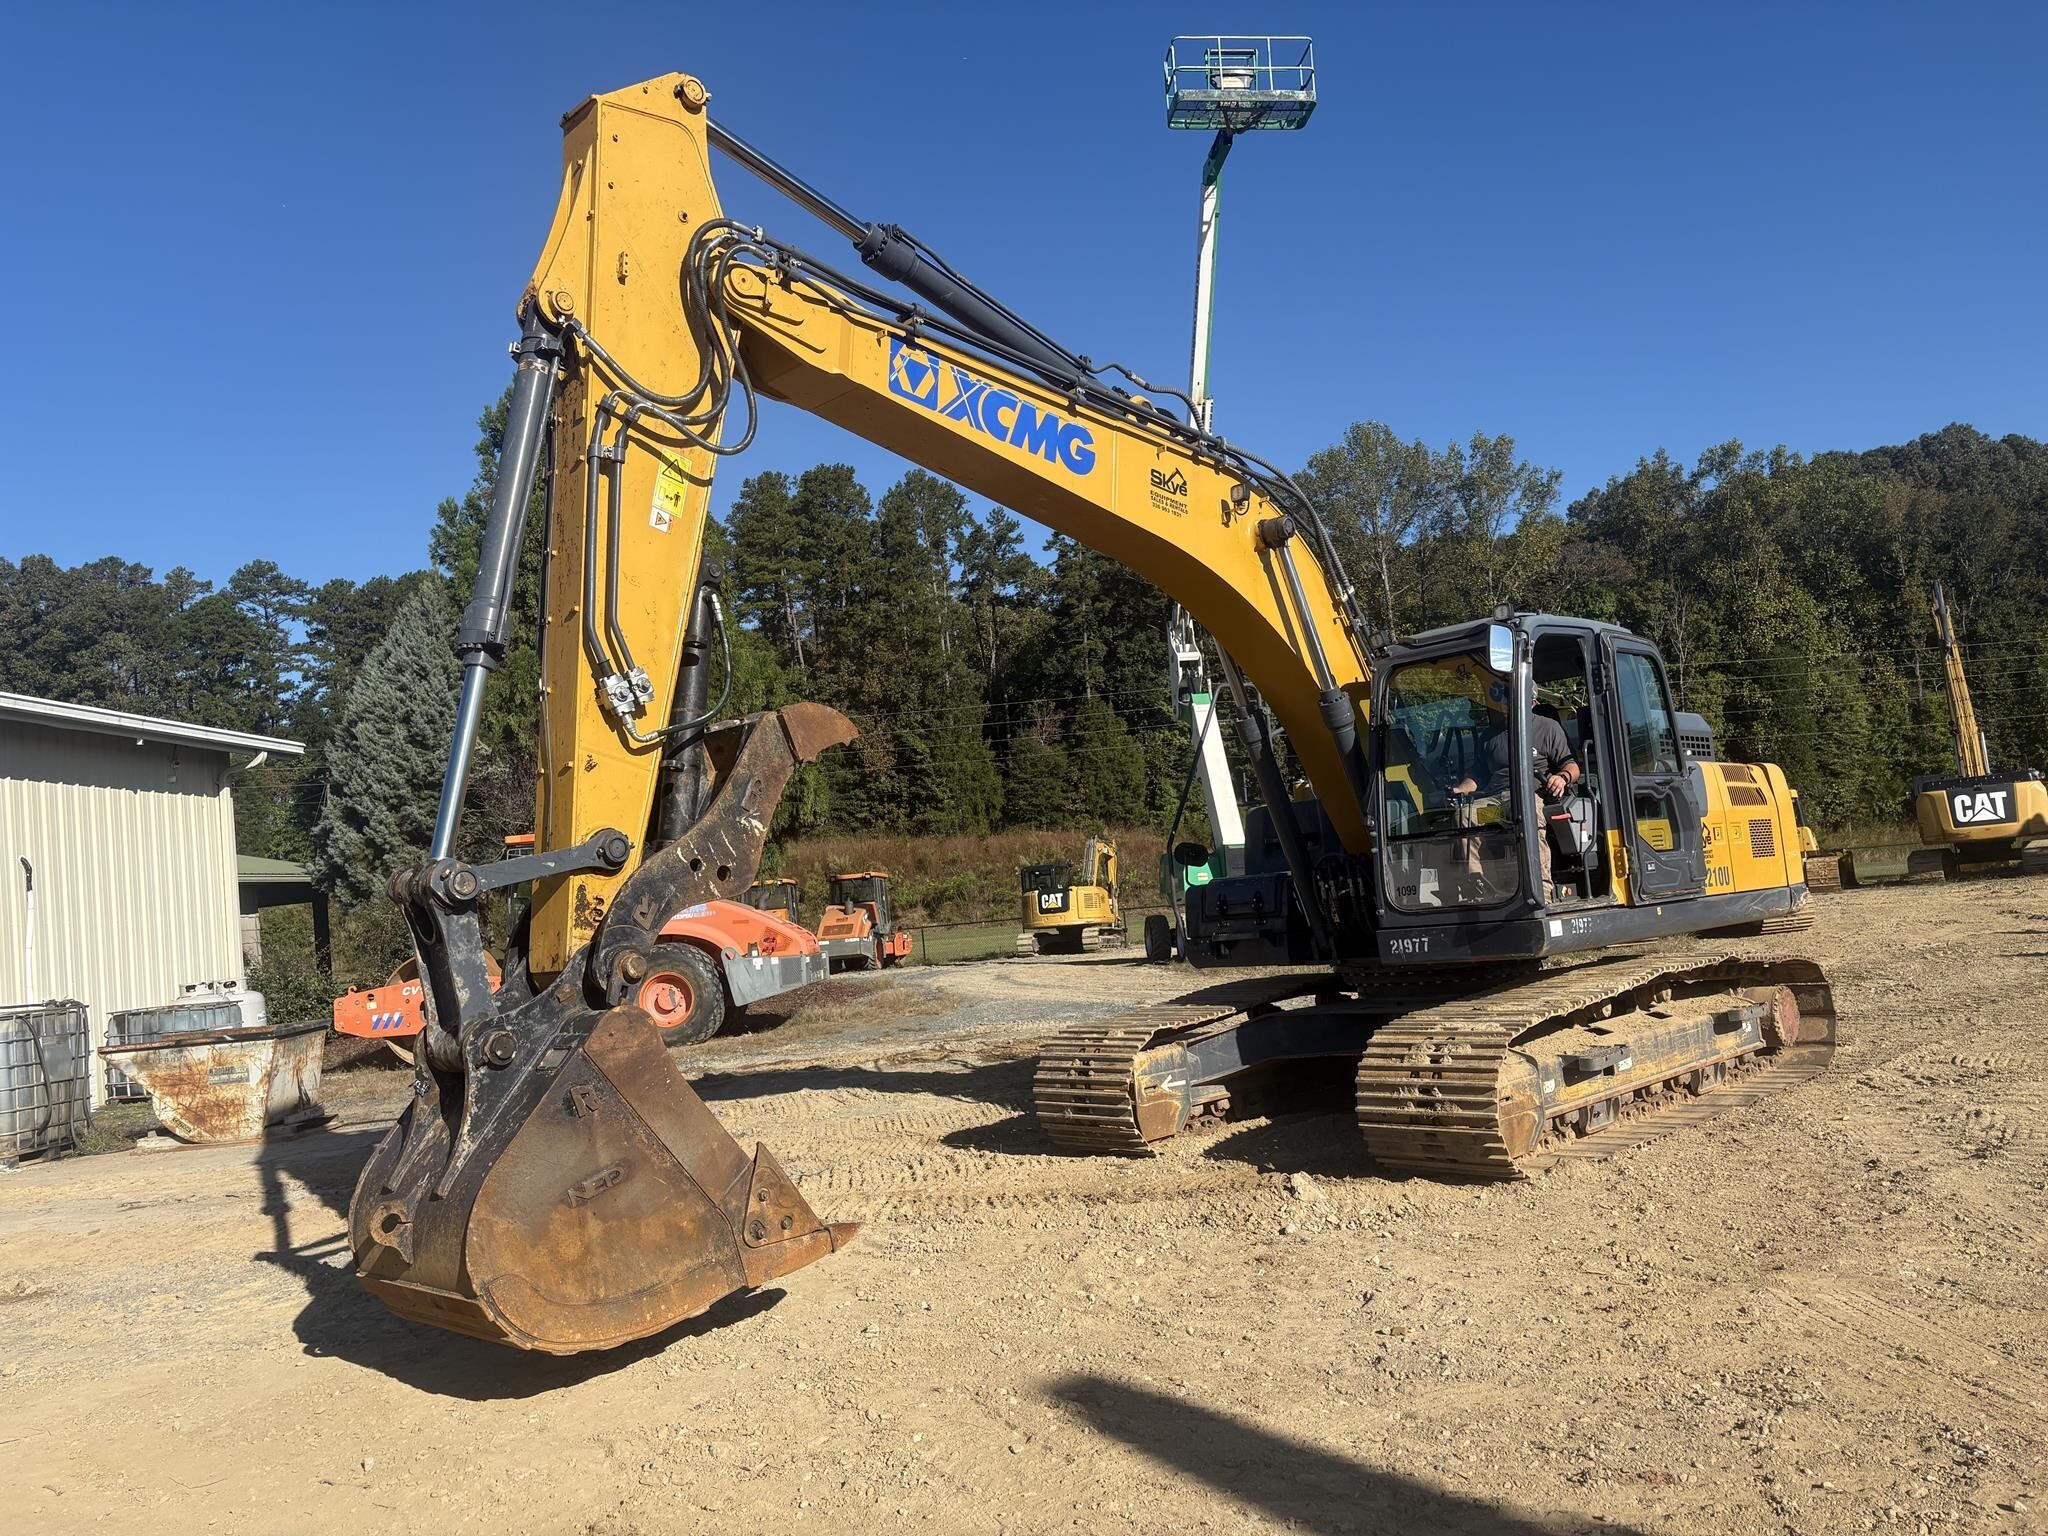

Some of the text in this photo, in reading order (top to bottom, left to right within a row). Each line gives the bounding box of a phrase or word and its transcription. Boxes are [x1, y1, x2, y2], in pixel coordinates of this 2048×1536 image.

[938, 365, 1097, 476] XCMG
[1150, 490, 1188, 509] EQUIPMENT
[1150, 496, 1164, 505] SALES
[1169, 502, 1188, 515] RENTALS
[1954, 791, 2007, 823] CAT
[1705, 866, 1730, 887] 210U
[1396, 885, 1417, 897] 1099
[1041, 893, 1063, 909] CAT
[1390, 937, 1429, 954] 21977
[402, 986, 424, 996] CV
